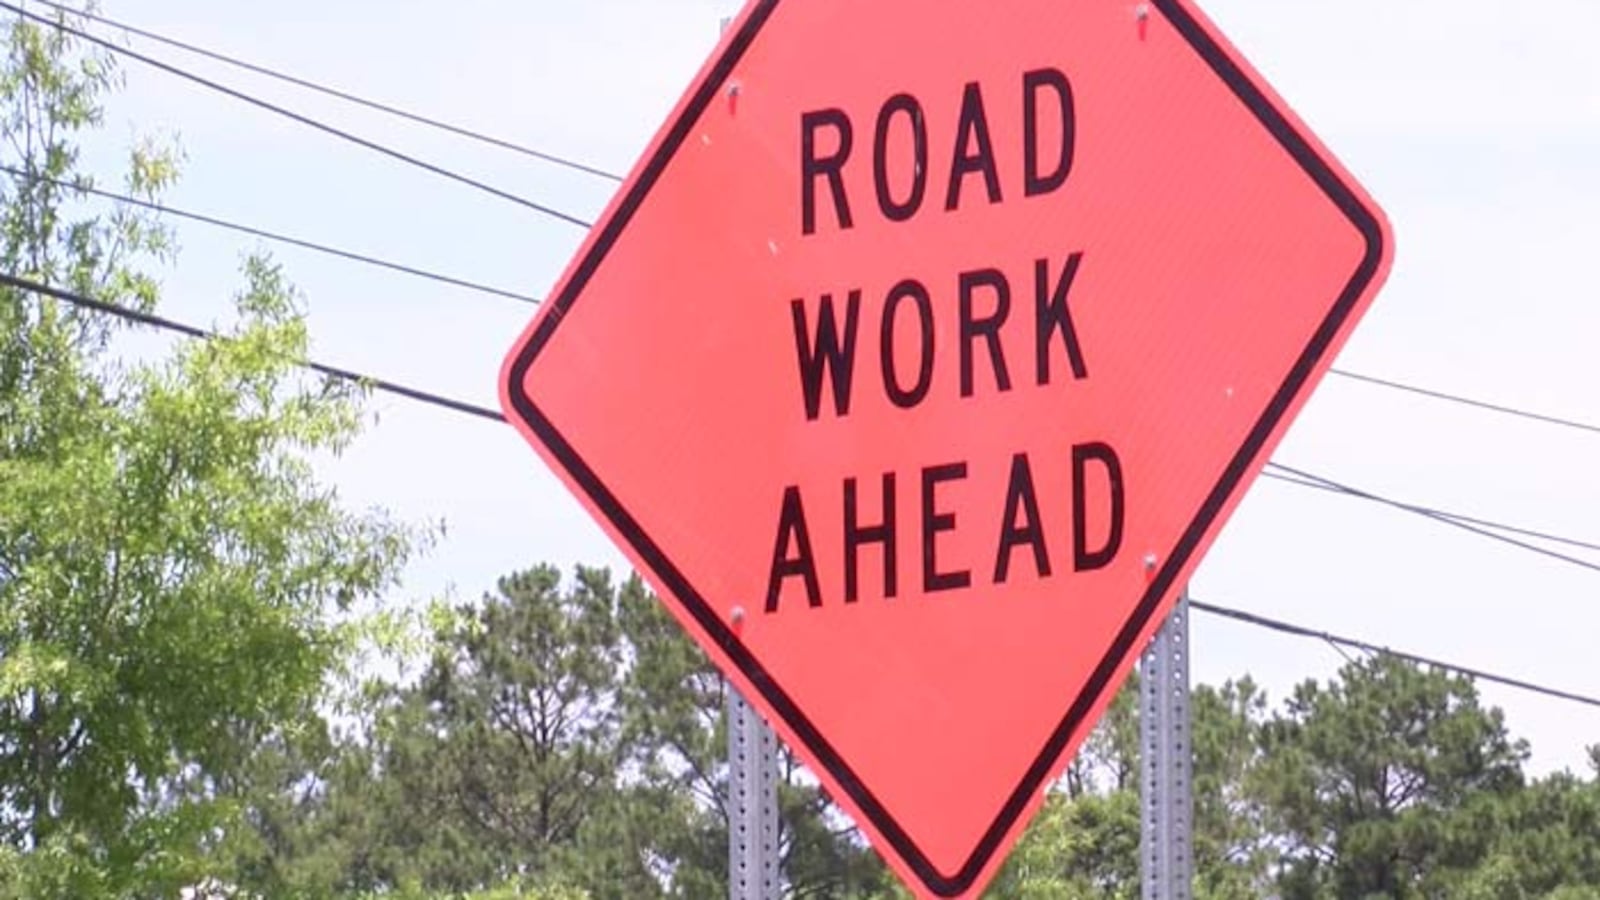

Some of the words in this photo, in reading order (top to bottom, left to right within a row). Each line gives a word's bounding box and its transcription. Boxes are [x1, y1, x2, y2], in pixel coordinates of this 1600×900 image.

[800, 67, 1076, 236] ROAD
[790, 252, 1089, 421] WORK
[764, 441, 1126, 614] AHEAD
